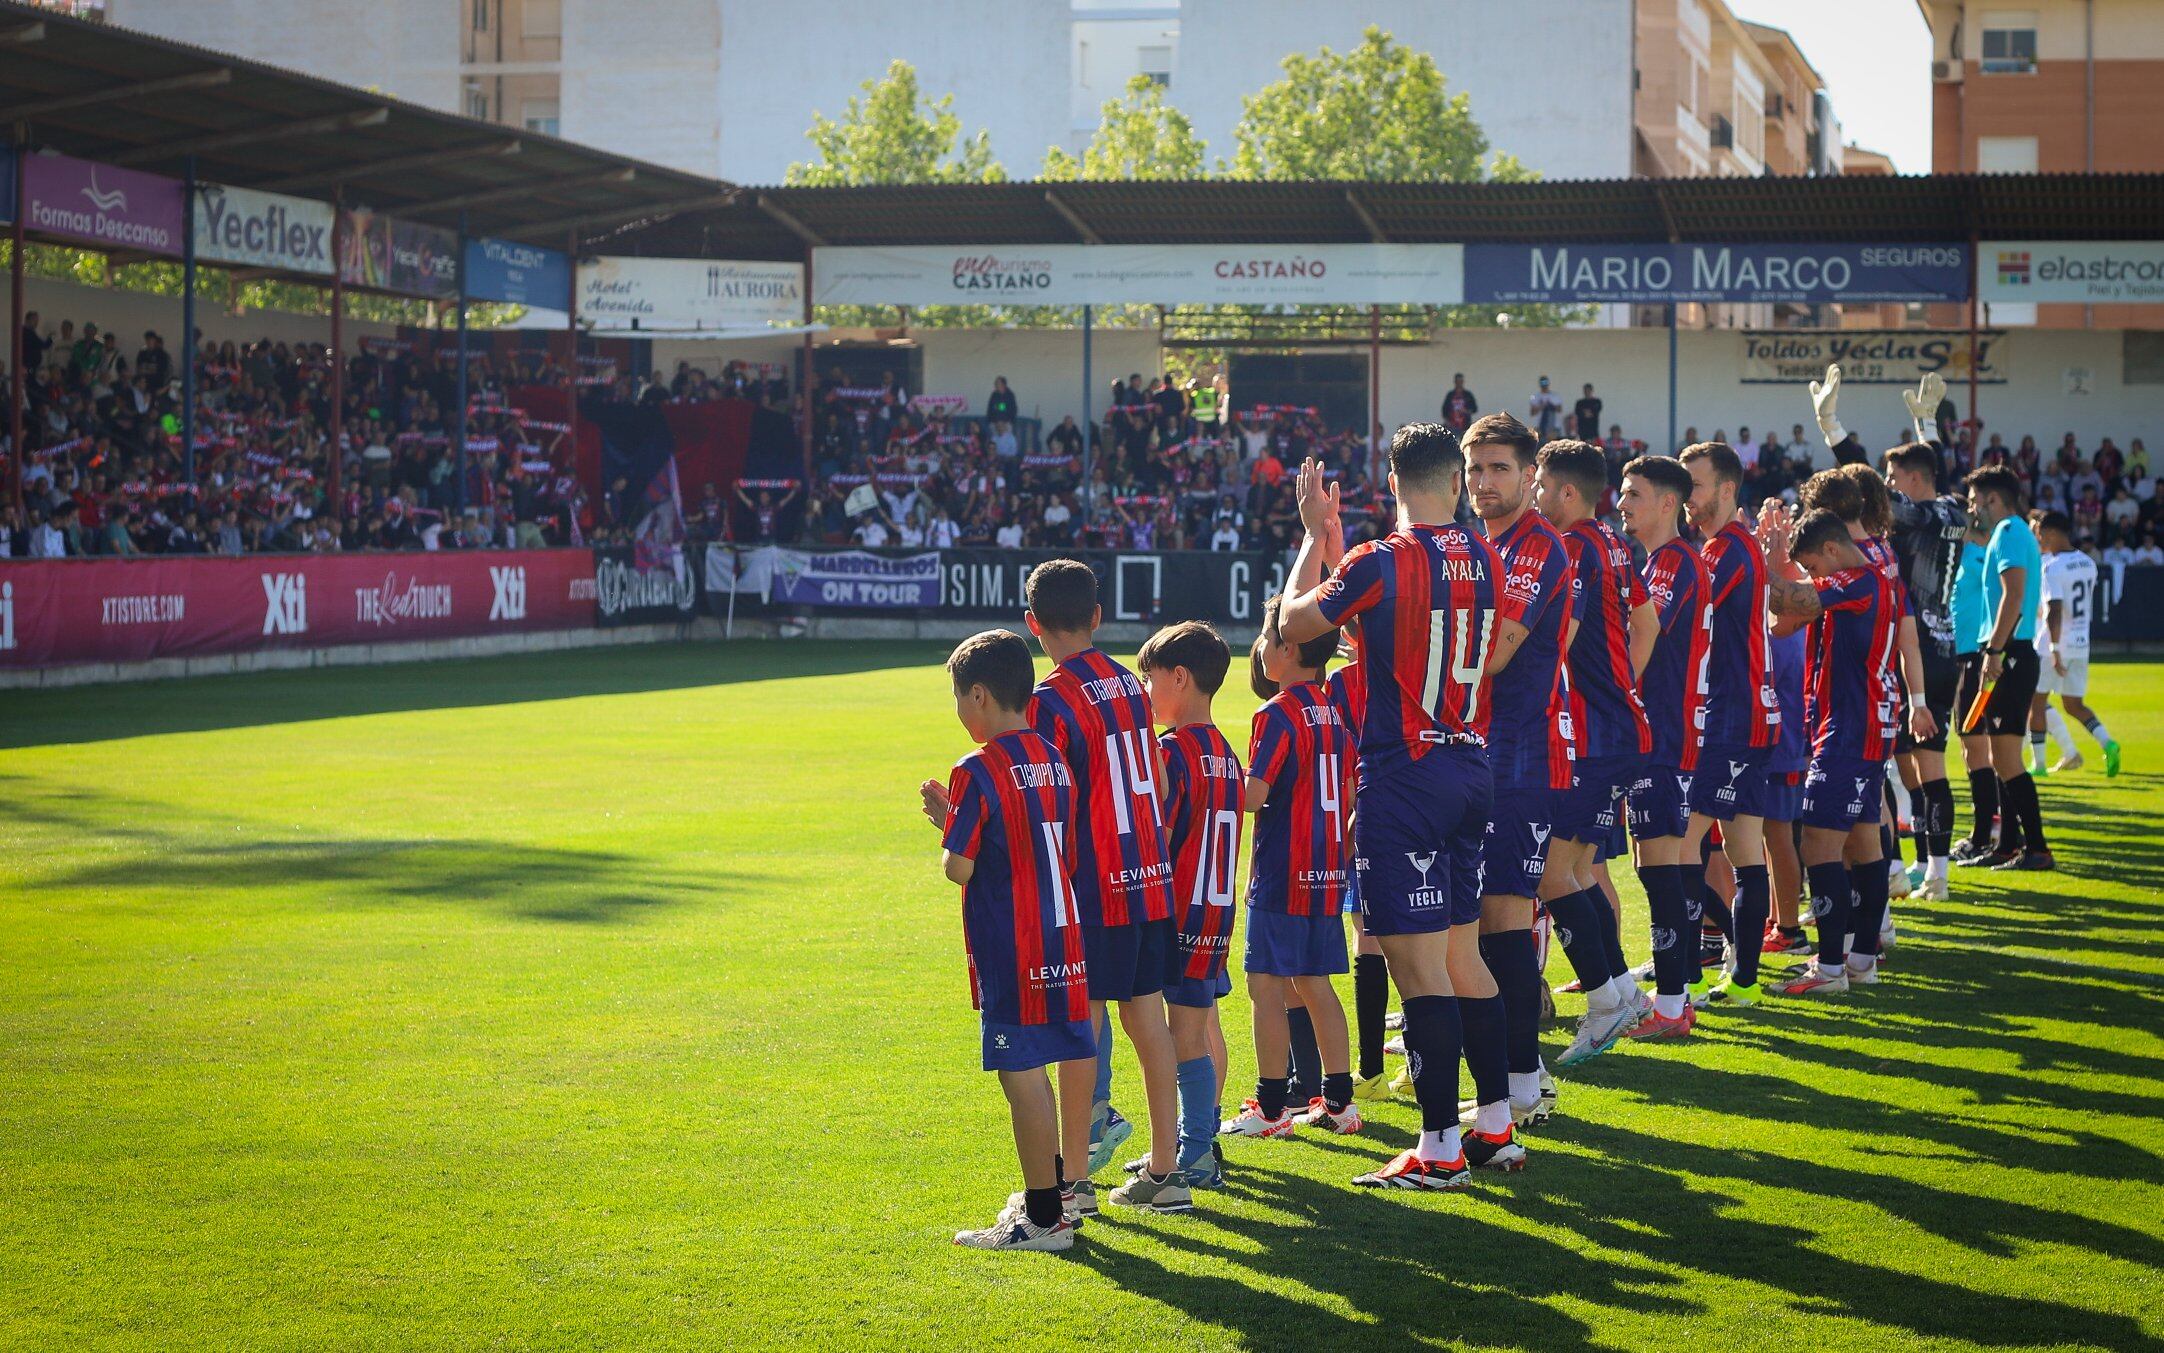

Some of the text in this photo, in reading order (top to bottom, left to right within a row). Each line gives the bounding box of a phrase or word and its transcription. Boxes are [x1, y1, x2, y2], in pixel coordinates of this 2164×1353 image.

[31, 200, 169, 248] Formas Descanso
[201, 186, 324, 260] Yecflex
[1215, 255, 1326, 279] CASTAÑO
[1861, 248, 1962, 268] SEGUROS
[586, 279, 633, 294] Hotel
[722, 281, 798, 298] AURORA
[953, 267, 1050, 289] CASTAÑO
[585, 296, 654, 312] Avenida
[1746, 340, 1821, 359] Toldos
[1441, 559, 1486, 581] AYALA
[489, 565, 527, 621] Xti
[822, 580, 921, 605] ON TOUR
[940, 562, 1033, 608] SIM.E
[102, 594, 185, 625] XTISTORE.COM
[261, 571, 308, 636] Xti
[355, 588, 379, 624] THE
[413, 583, 450, 618] TOUCH
[1421, 608, 1496, 723] 14
[1093, 675, 1127, 701] GRUPO
[1023, 762, 1055, 788] GRUPO
[1105, 727, 1163, 836] 14
[1319, 753, 1342, 843] 4
[1191, 808, 1238, 907] 10
[1126, 883, 1149, 892] NATURAL
[1407, 889, 1444, 907] YECLA
[1178, 932, 1230, 947] EVANTIN
[1045, 981, 1074, 989] NATURAL
